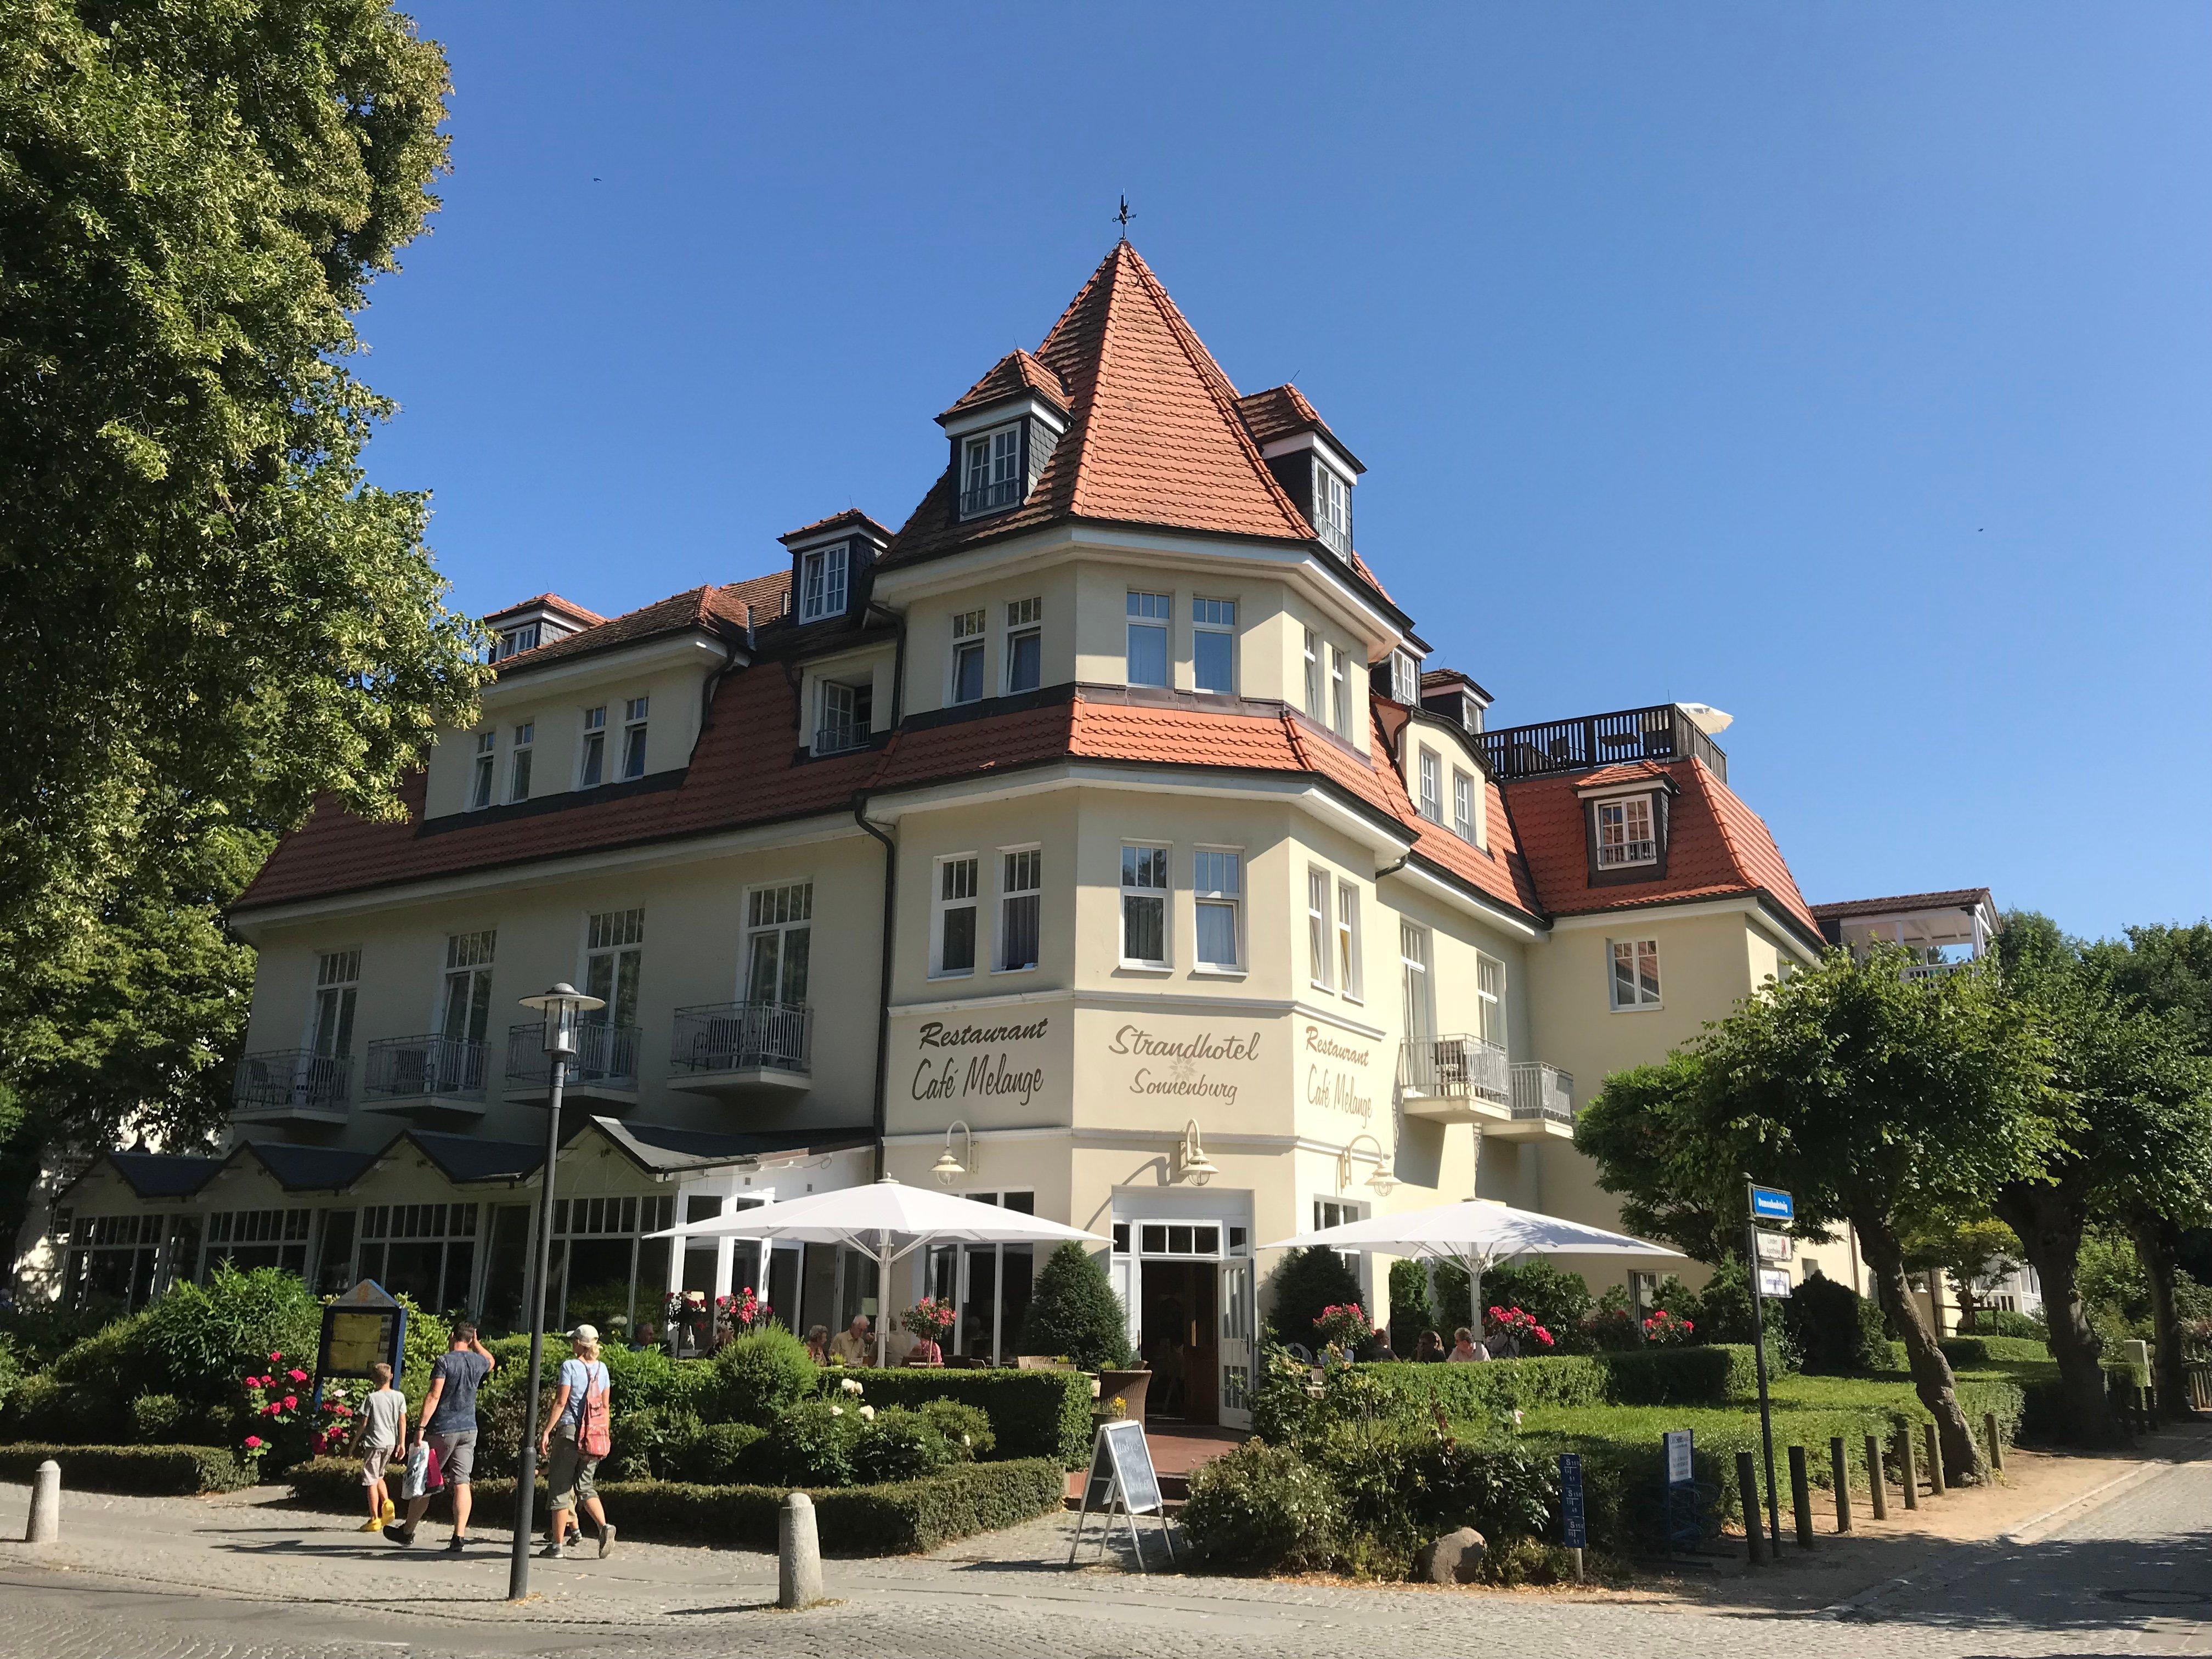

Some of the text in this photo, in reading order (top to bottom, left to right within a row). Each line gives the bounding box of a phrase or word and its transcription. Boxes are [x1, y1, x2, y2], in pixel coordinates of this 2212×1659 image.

[919, 1017, 1048, 1049] Restaurant
[1108, 1024, 1261, 1061] Strandhotel
[1306, 1025, 1369, 1067] Restaurant
[912, 1053, 1044, 1105] Café Melange
[1128, 1068, 1238, 1105] Sonnenburg
[1308, 1063, 1373, 1129] Café Melange
